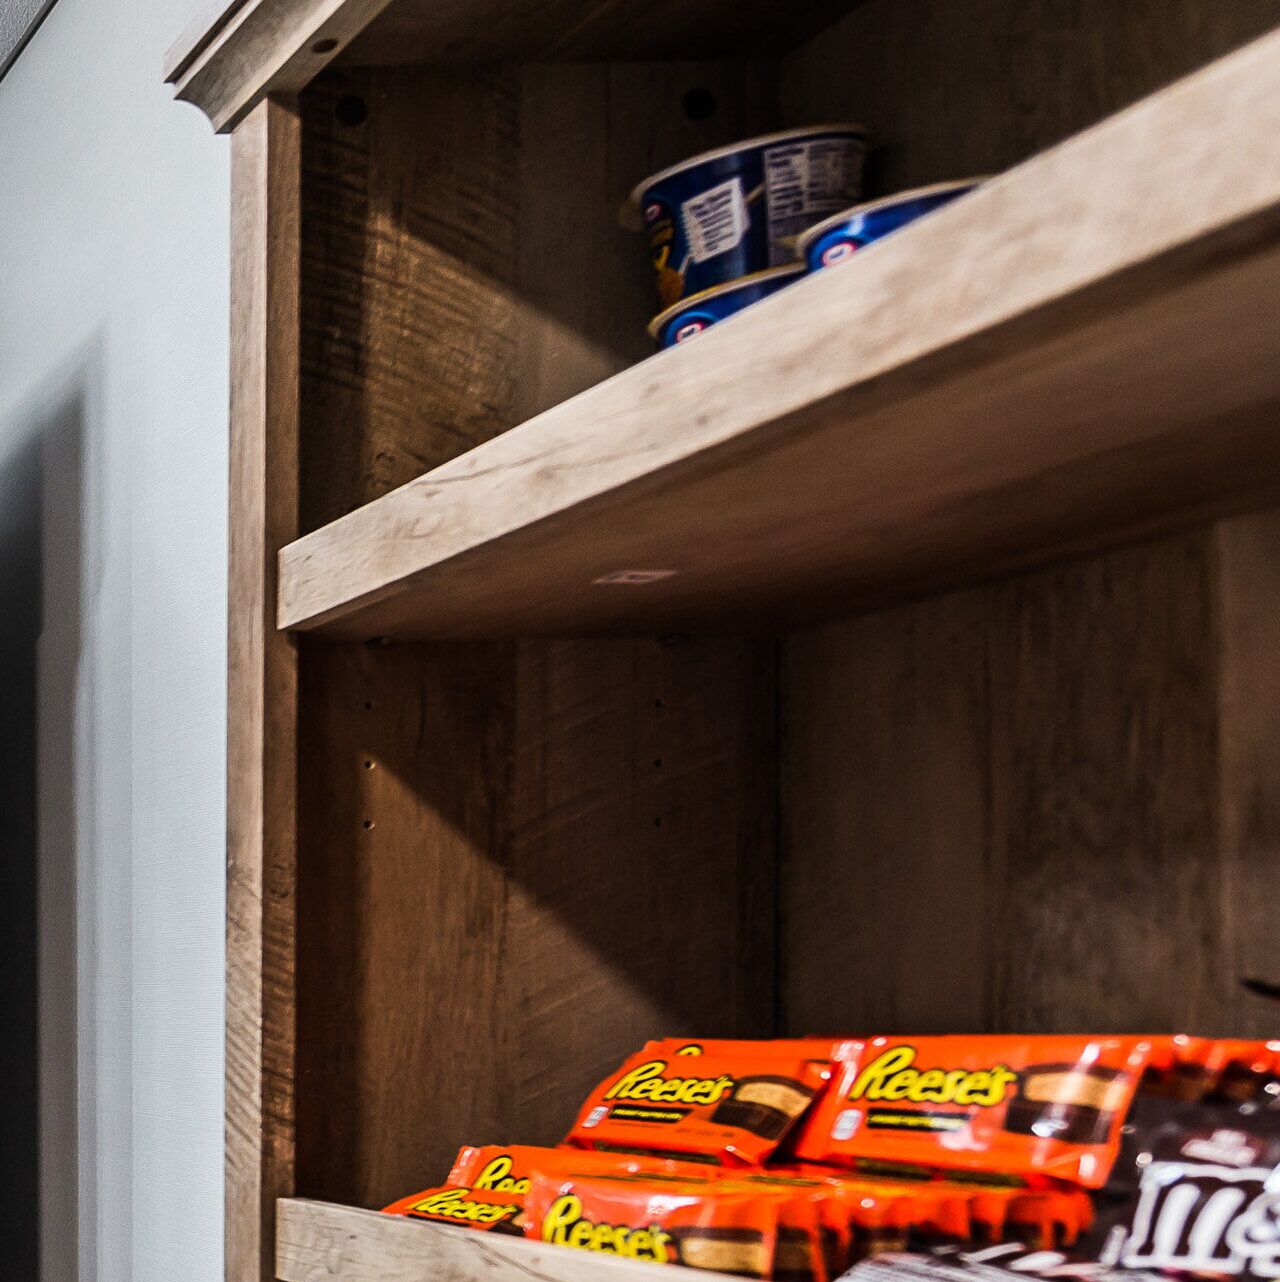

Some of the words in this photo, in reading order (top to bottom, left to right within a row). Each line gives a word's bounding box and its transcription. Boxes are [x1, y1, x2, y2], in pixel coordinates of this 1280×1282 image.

[604, 1060, 734, 1105] Reese's
[848, 1045, 1018, 1107] Reese's
[407, 1188, 519, 1223] Reese's
[542, 1193, 673, 1264] Reese's
